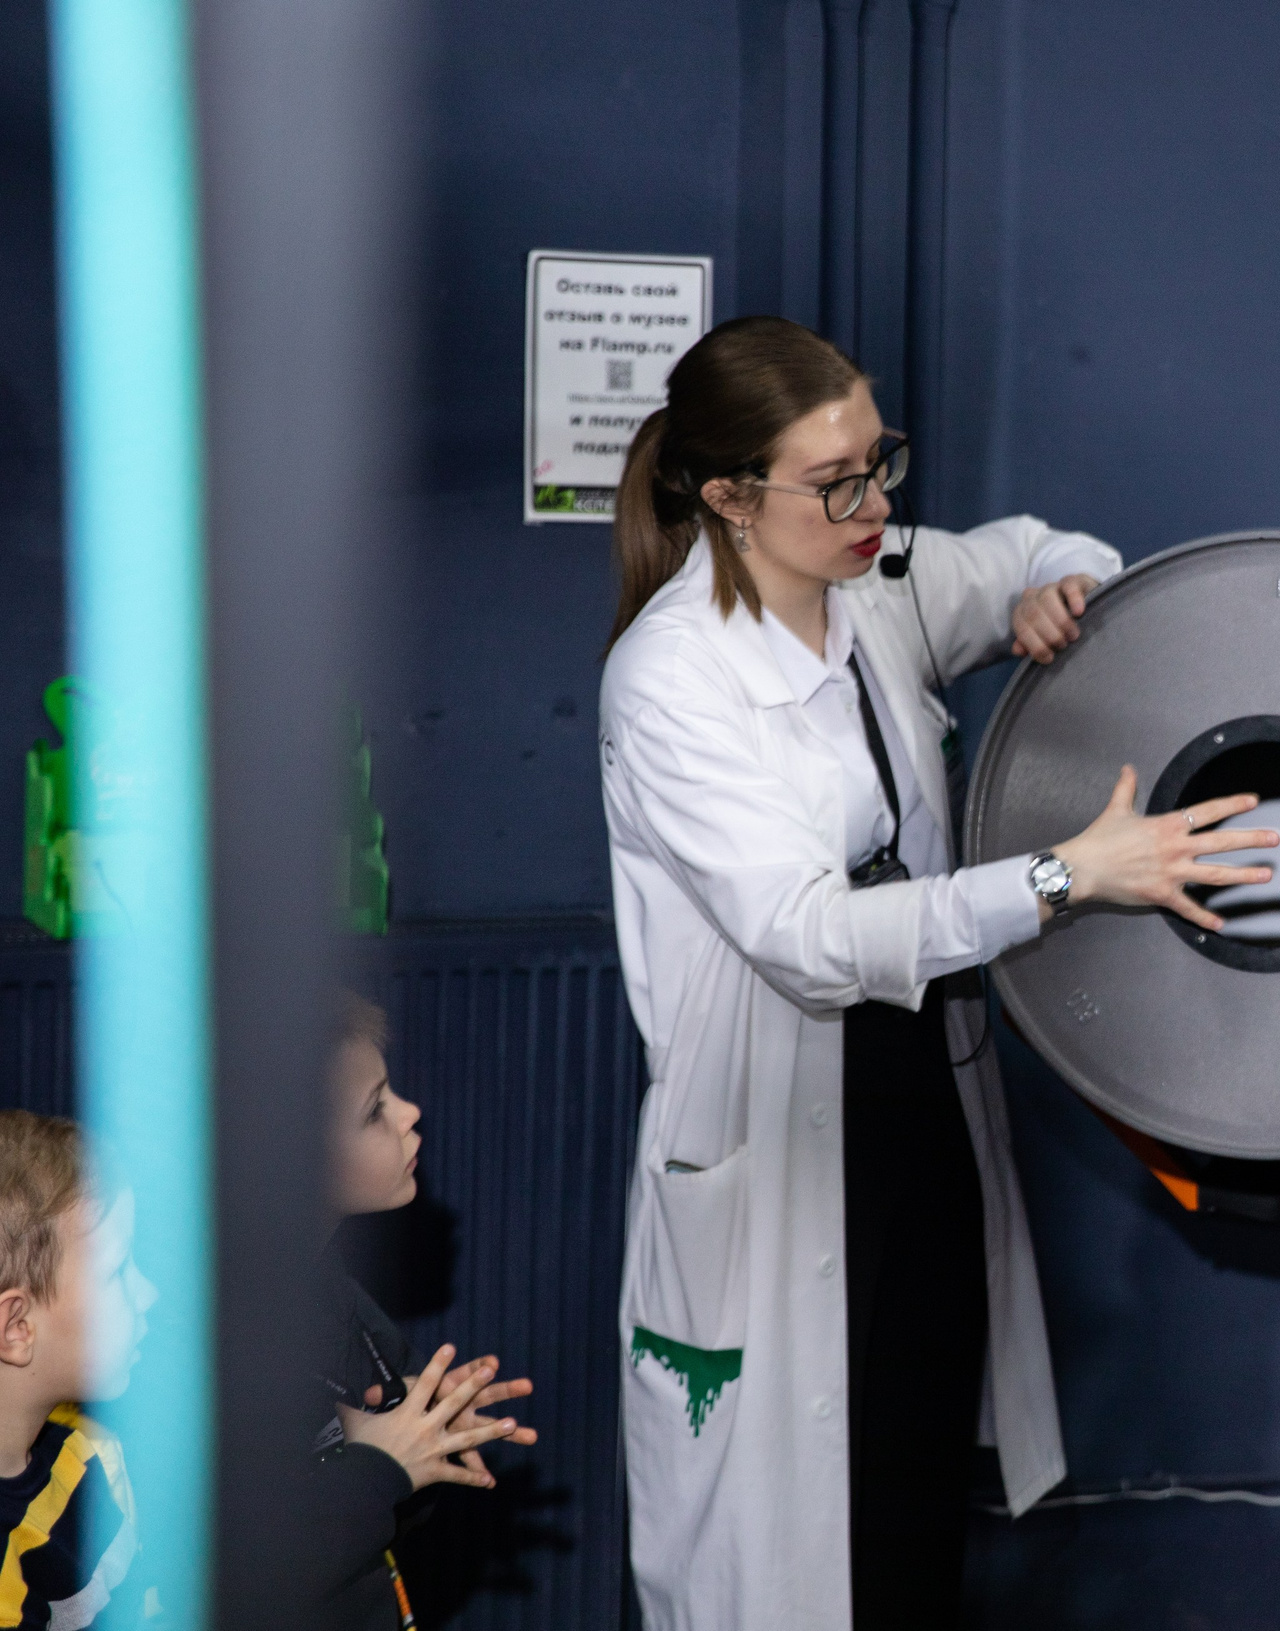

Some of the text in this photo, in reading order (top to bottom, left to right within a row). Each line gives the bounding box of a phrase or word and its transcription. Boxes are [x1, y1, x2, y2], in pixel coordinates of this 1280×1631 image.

[556, 278, 680, 297] Оставь свой
[544, 309, 689, 330] отзыв о музее
[559, 336, 675, 355] на Flamp.ru
[569, 415, 582, 426] и
